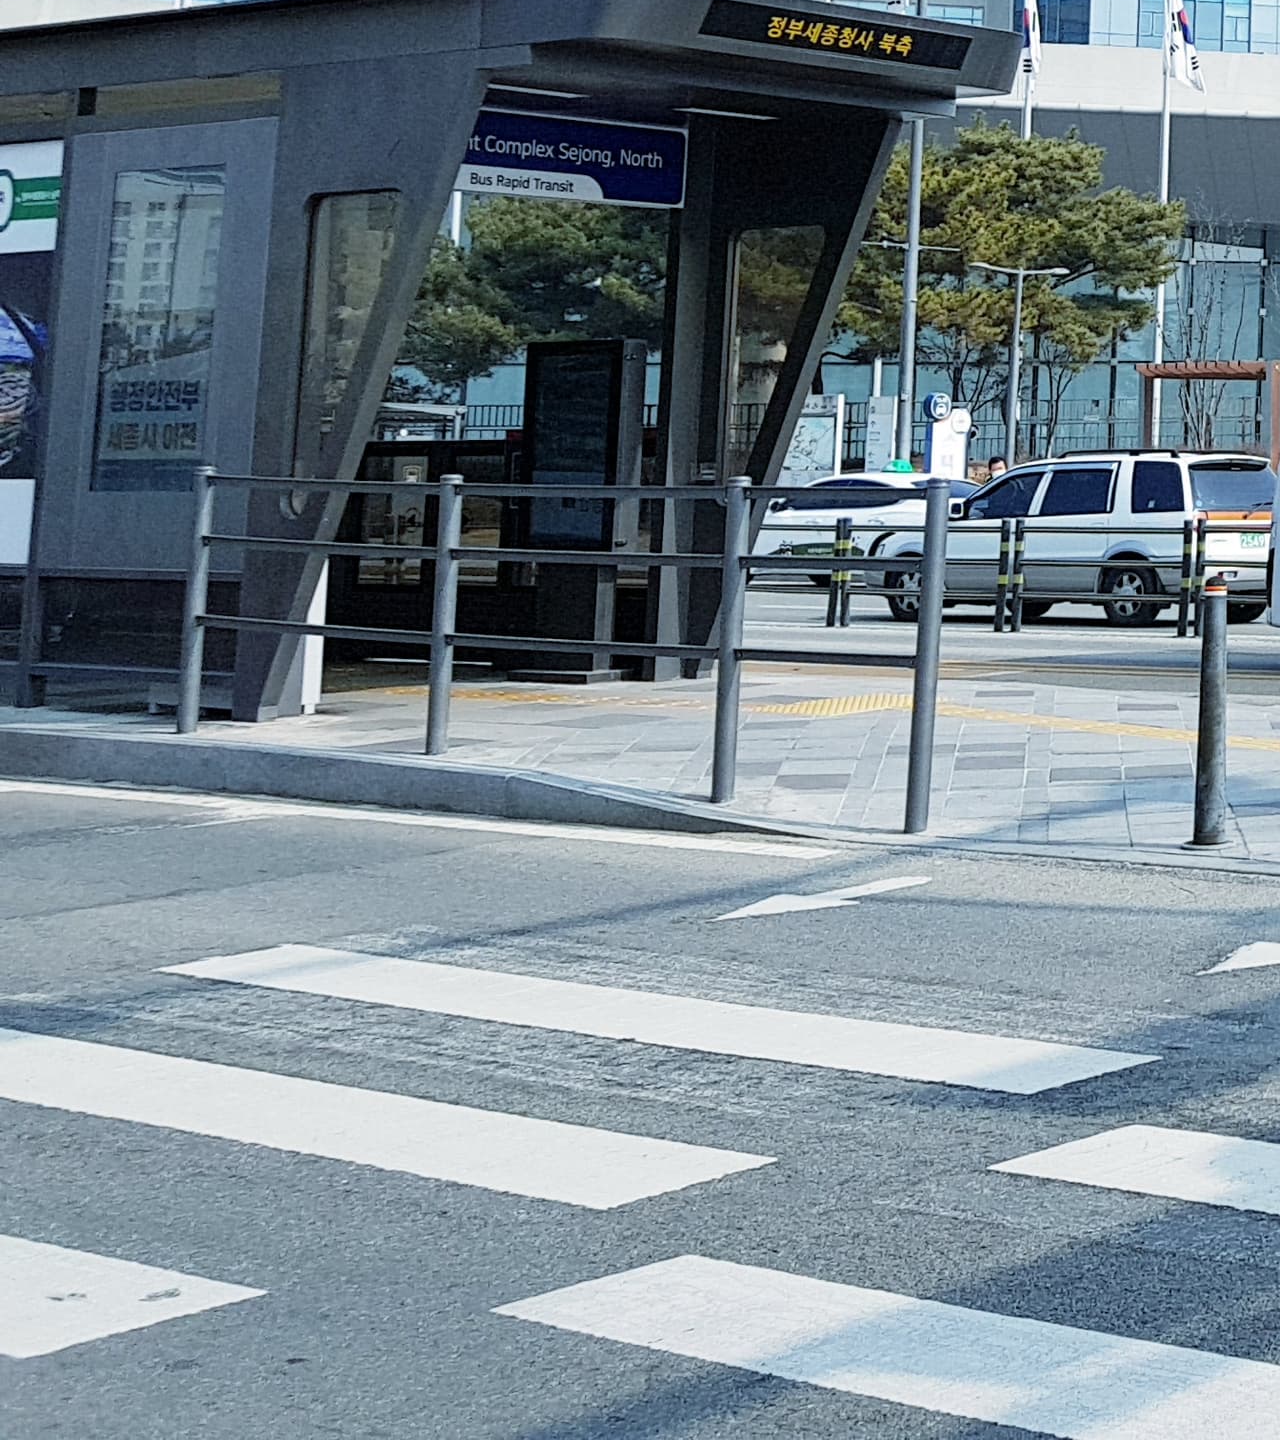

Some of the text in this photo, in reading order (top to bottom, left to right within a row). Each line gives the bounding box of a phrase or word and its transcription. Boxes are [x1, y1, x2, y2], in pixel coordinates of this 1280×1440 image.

[767, 16, 914, 57] 정부세종청사 북측
[484, 135, 555, 160] Complex
[558, 142, 616, 168] Sejong,
[620, 149, 663, 169] North
[470, 172, 574, 193] Bus Rapid Transit
